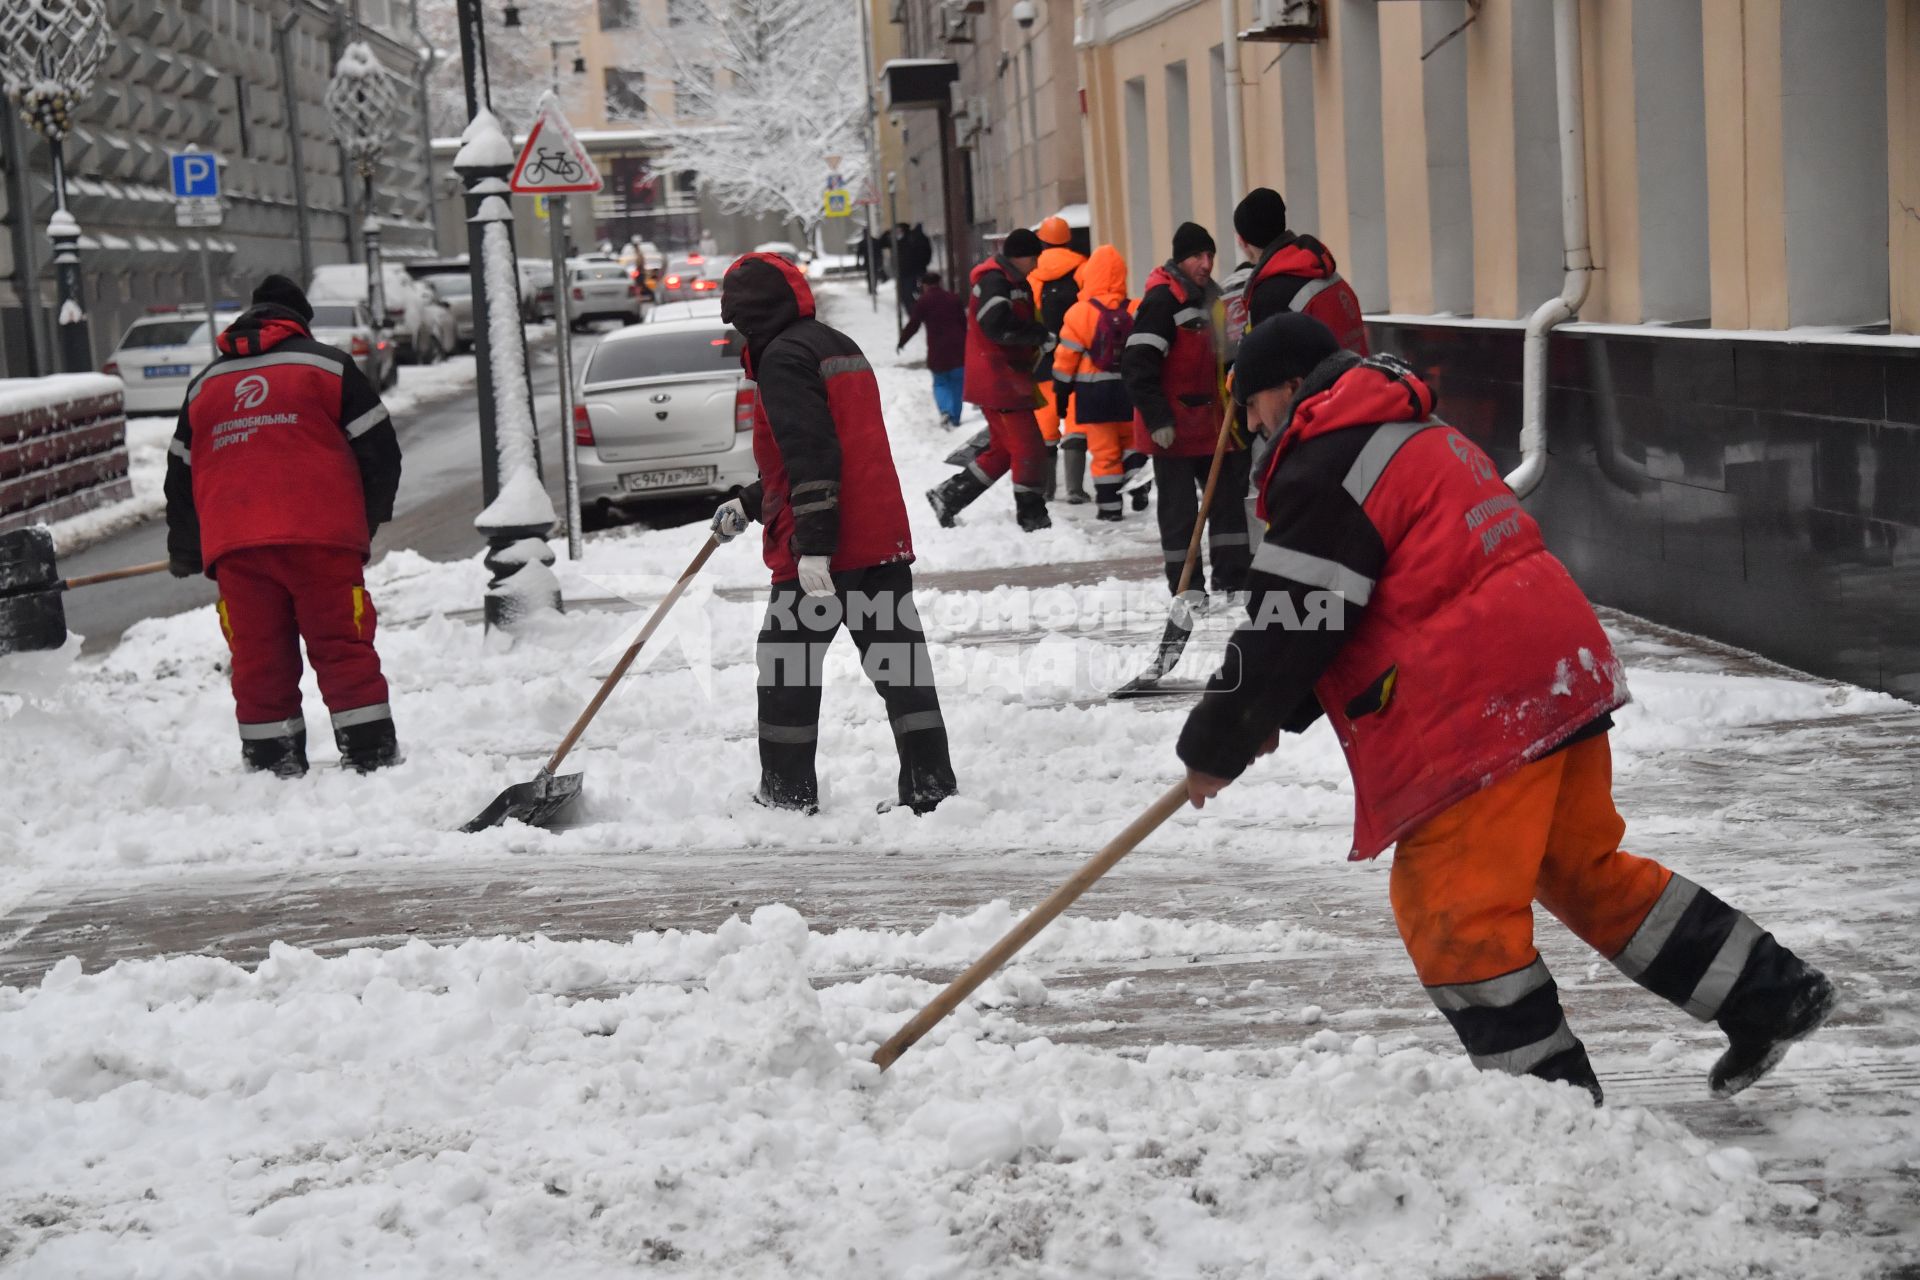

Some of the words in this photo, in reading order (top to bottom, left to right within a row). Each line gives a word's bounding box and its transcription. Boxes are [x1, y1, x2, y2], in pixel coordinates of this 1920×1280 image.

[184, 158, 210, 194] P
[211, 413, 299, 436] АВТОМОБИЛЬНЫЕ
[211, 431, 250, 452] ДОРОГИ
